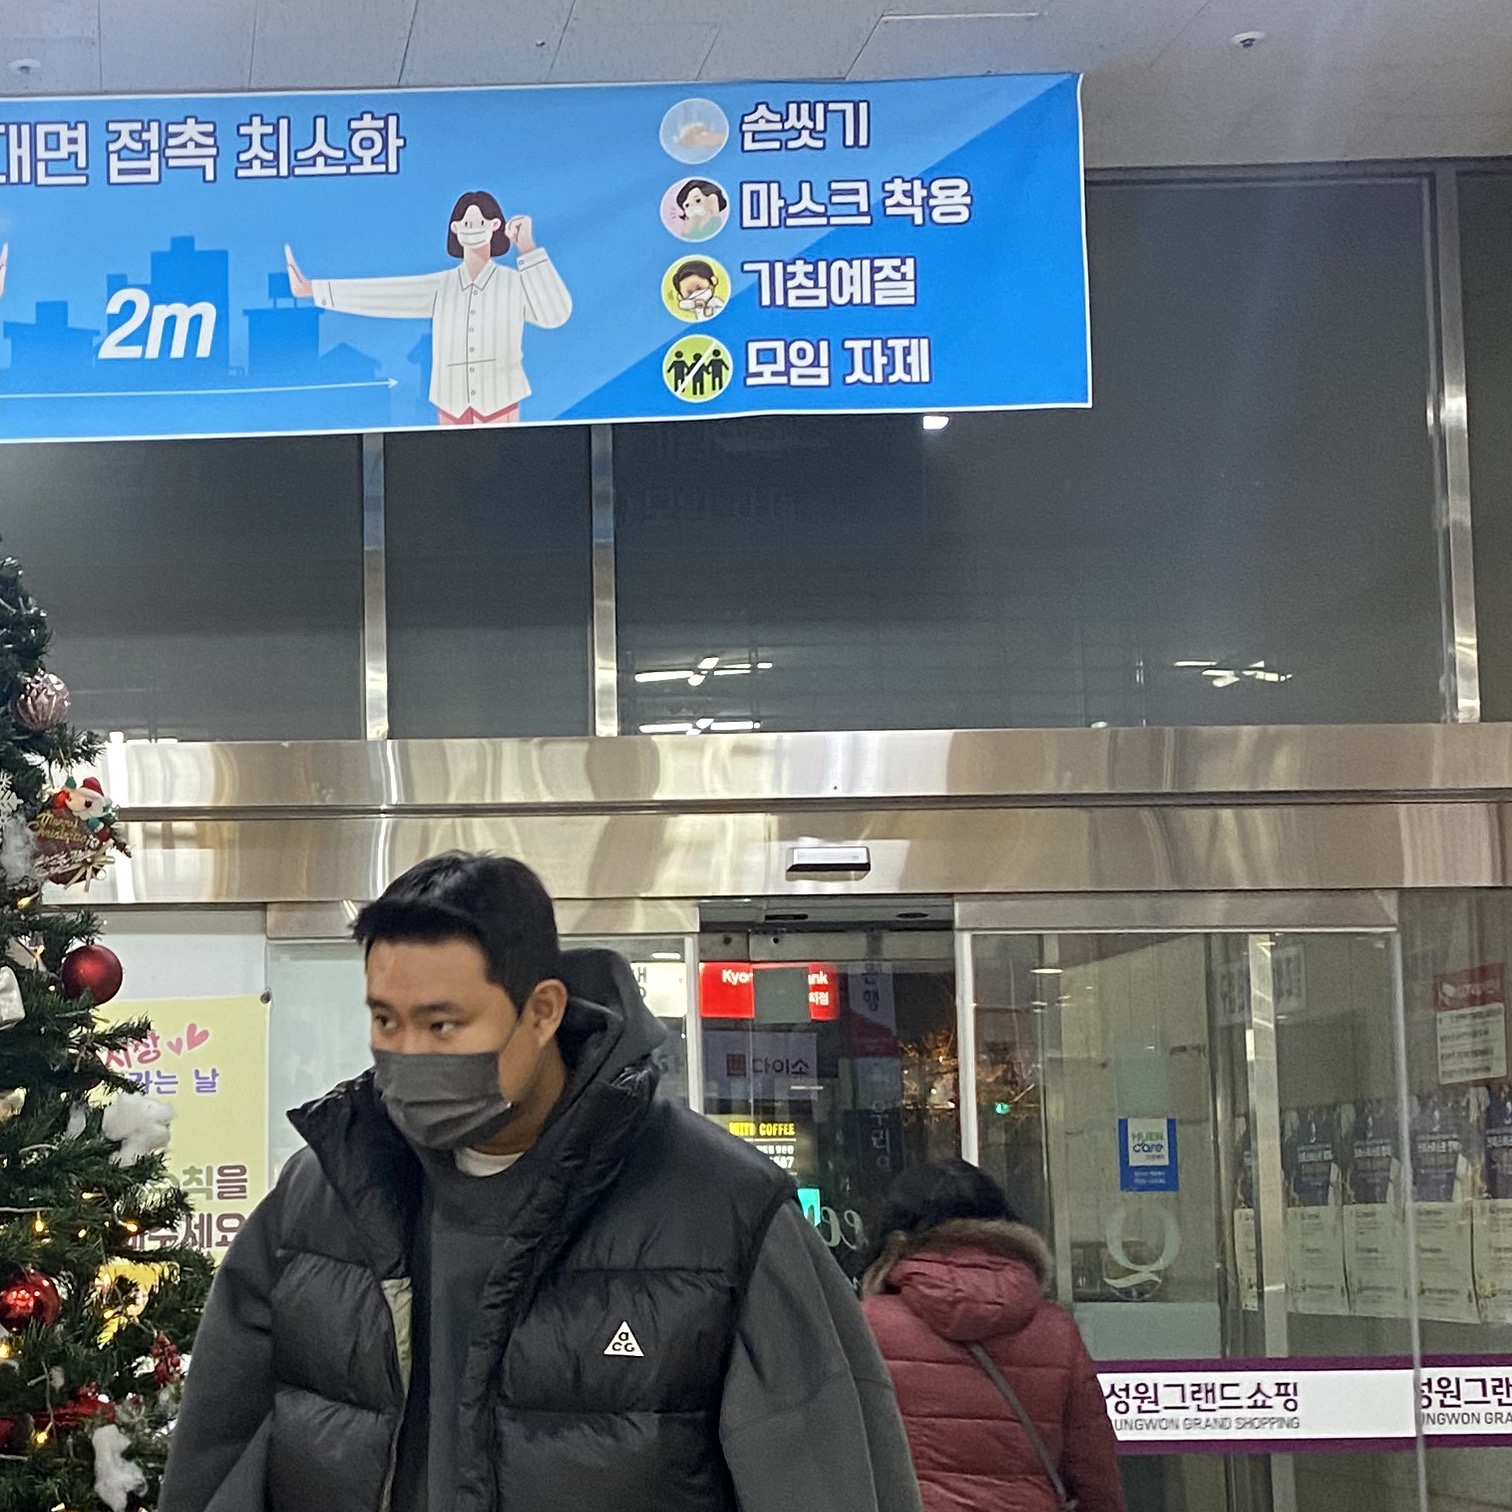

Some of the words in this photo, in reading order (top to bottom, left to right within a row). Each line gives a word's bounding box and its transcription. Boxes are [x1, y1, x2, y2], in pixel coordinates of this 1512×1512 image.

[740, 100, 870, 150] 손씻기
[107, 116, 218, 184] 접촉
[235, 113, 405, 180] 최소화
[740, 181, 870, 228] 마스크
[885, 178, 972, 226] 착용
[744, 258, 917, 308] 기침예절
[98, 288, 218, 359] 2m
[745, 338, 829, 386] 모임
[844, 338, 931, 385] 자제
[194, 1067, 220, 1093] 날
[752, 1057, 810, 1075] 다이소
[759, 1123, 796, 1136] COFFEE
[1105, 1382, 1299, 1414] 성원그랜드쇼핑
[1114, 1417, 1179, 1431] UNGWON
[1183, 1417, 1232, 1430] GRAND
[1235, 1417, 1300, 1430] SHOPPING
[1423, 1412, 1480, 1425] NGWON
